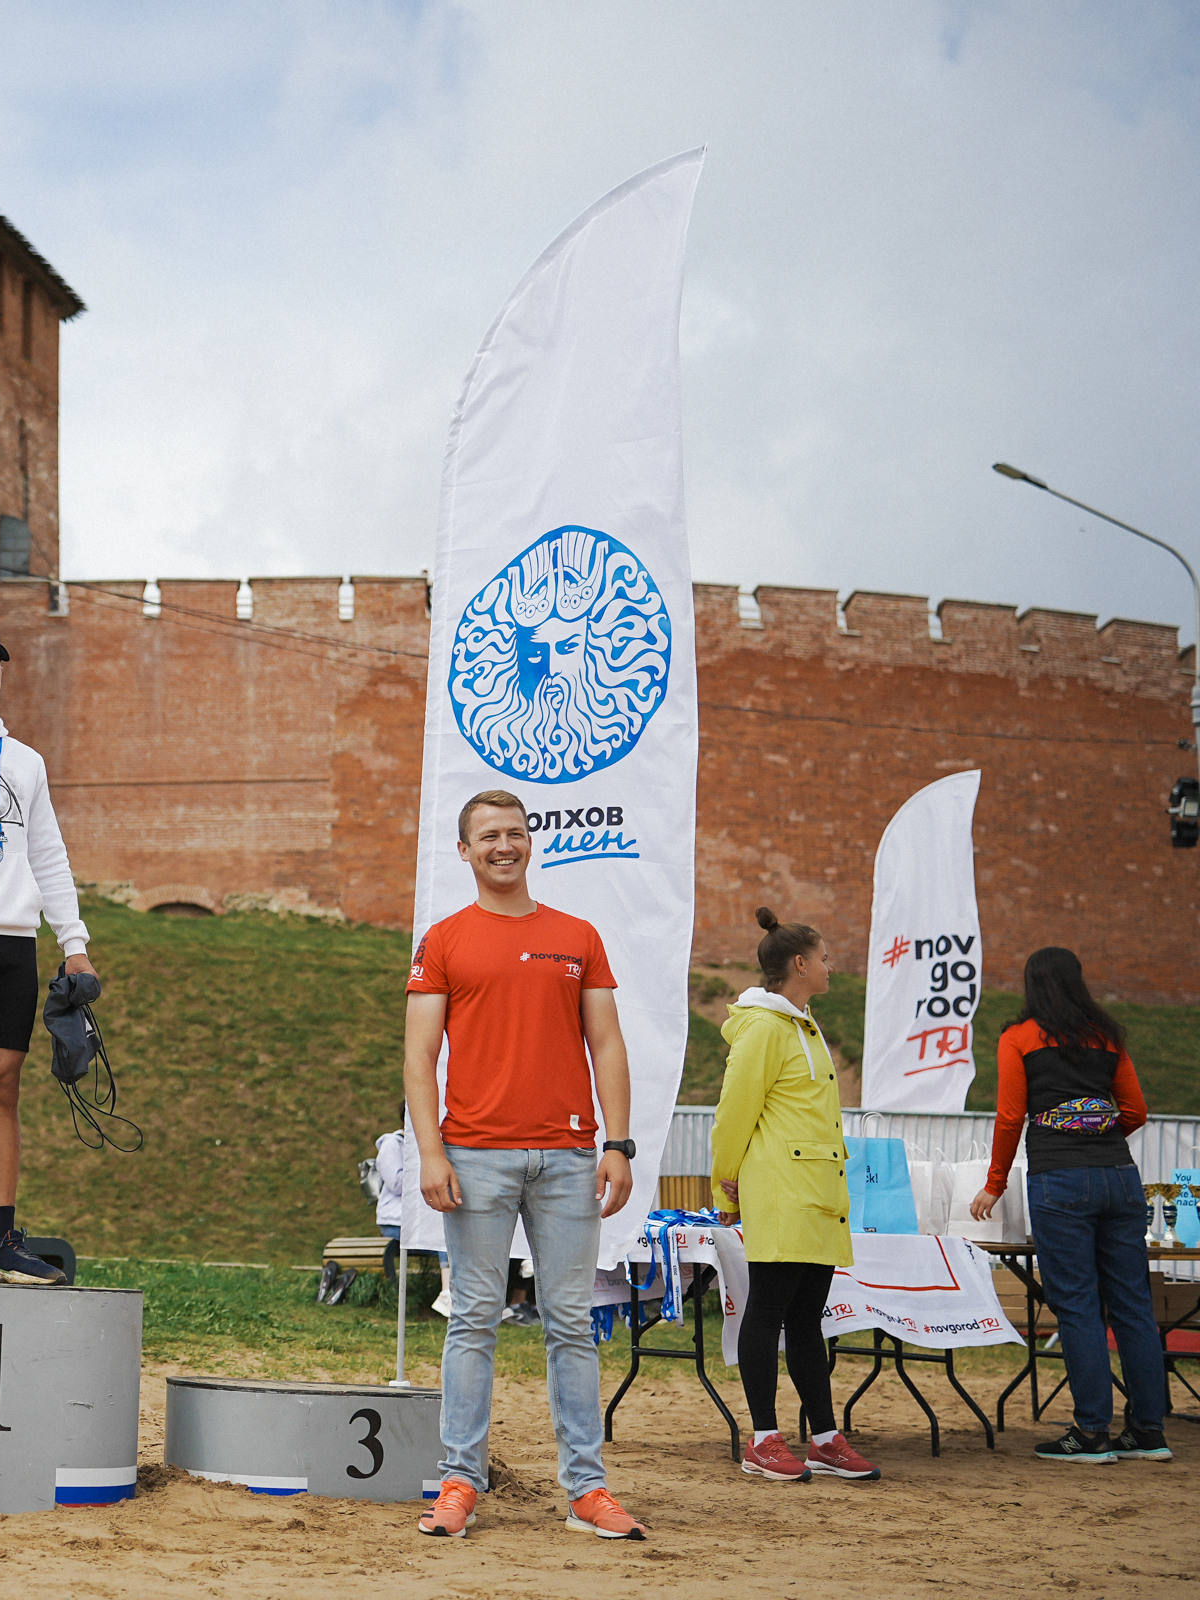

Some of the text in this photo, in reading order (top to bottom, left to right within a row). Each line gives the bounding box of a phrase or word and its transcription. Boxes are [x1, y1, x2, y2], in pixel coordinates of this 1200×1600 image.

[519, 952, 582, 965] #novgorod
[930, 961, 976, 992] go
[915, 984, 976, 1018] rod
[1175, 1174, 1192, 1182] You
[924, 1319, 980, 1334] #novgorod
[346, 1408, 385, 1479] 3
